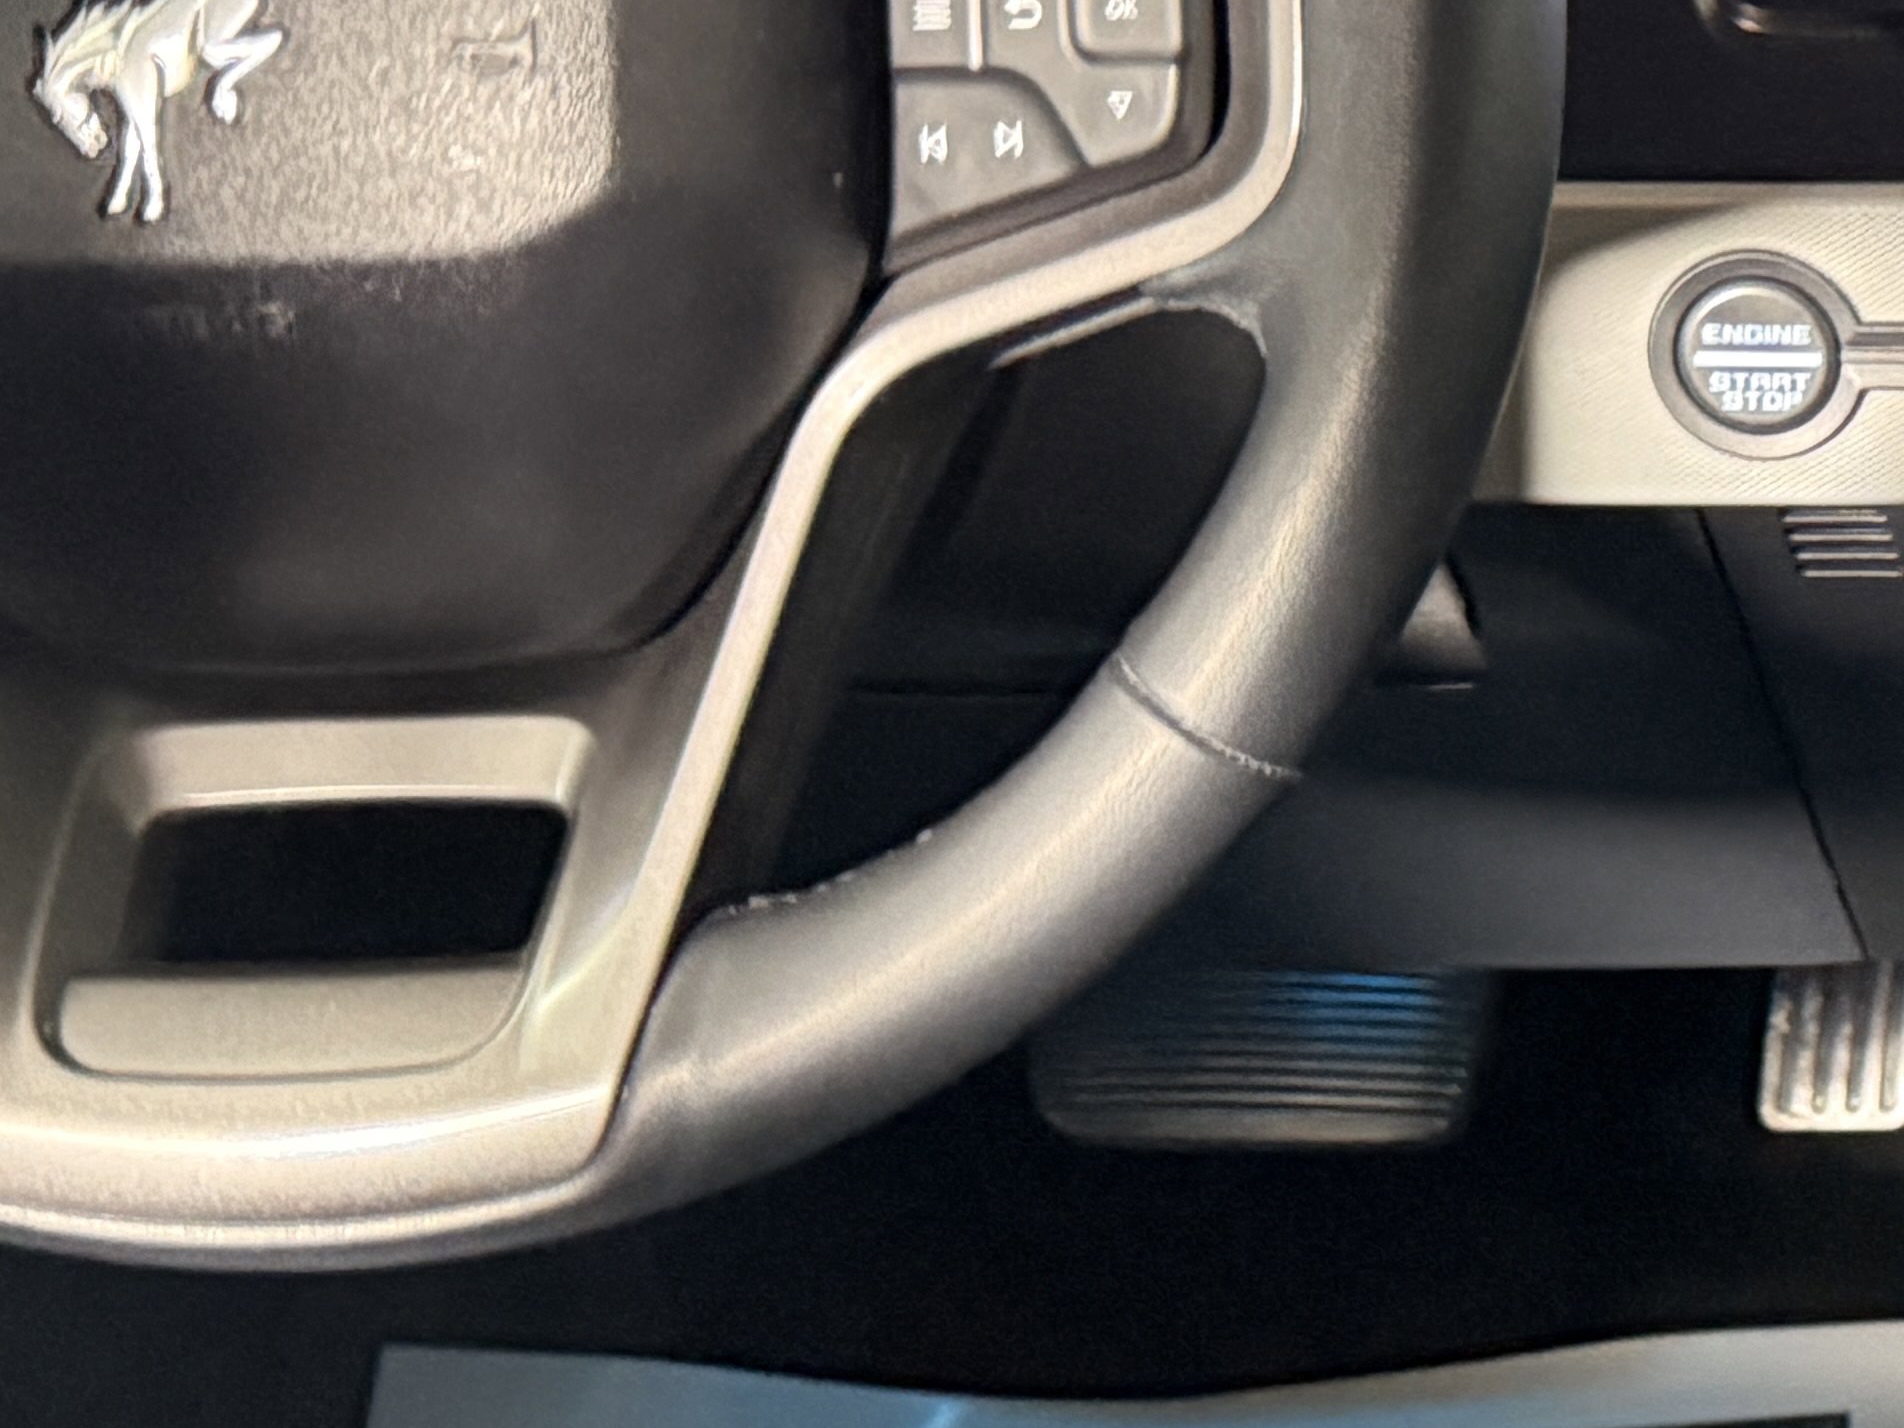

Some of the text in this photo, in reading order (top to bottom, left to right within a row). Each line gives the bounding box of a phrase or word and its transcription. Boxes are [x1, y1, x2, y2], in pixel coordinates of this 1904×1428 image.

[1702, 324, 1812, 345] ENGINE
[1708, 371, 1811, 393] START
[1721, 391, 1803, 411] STOP
